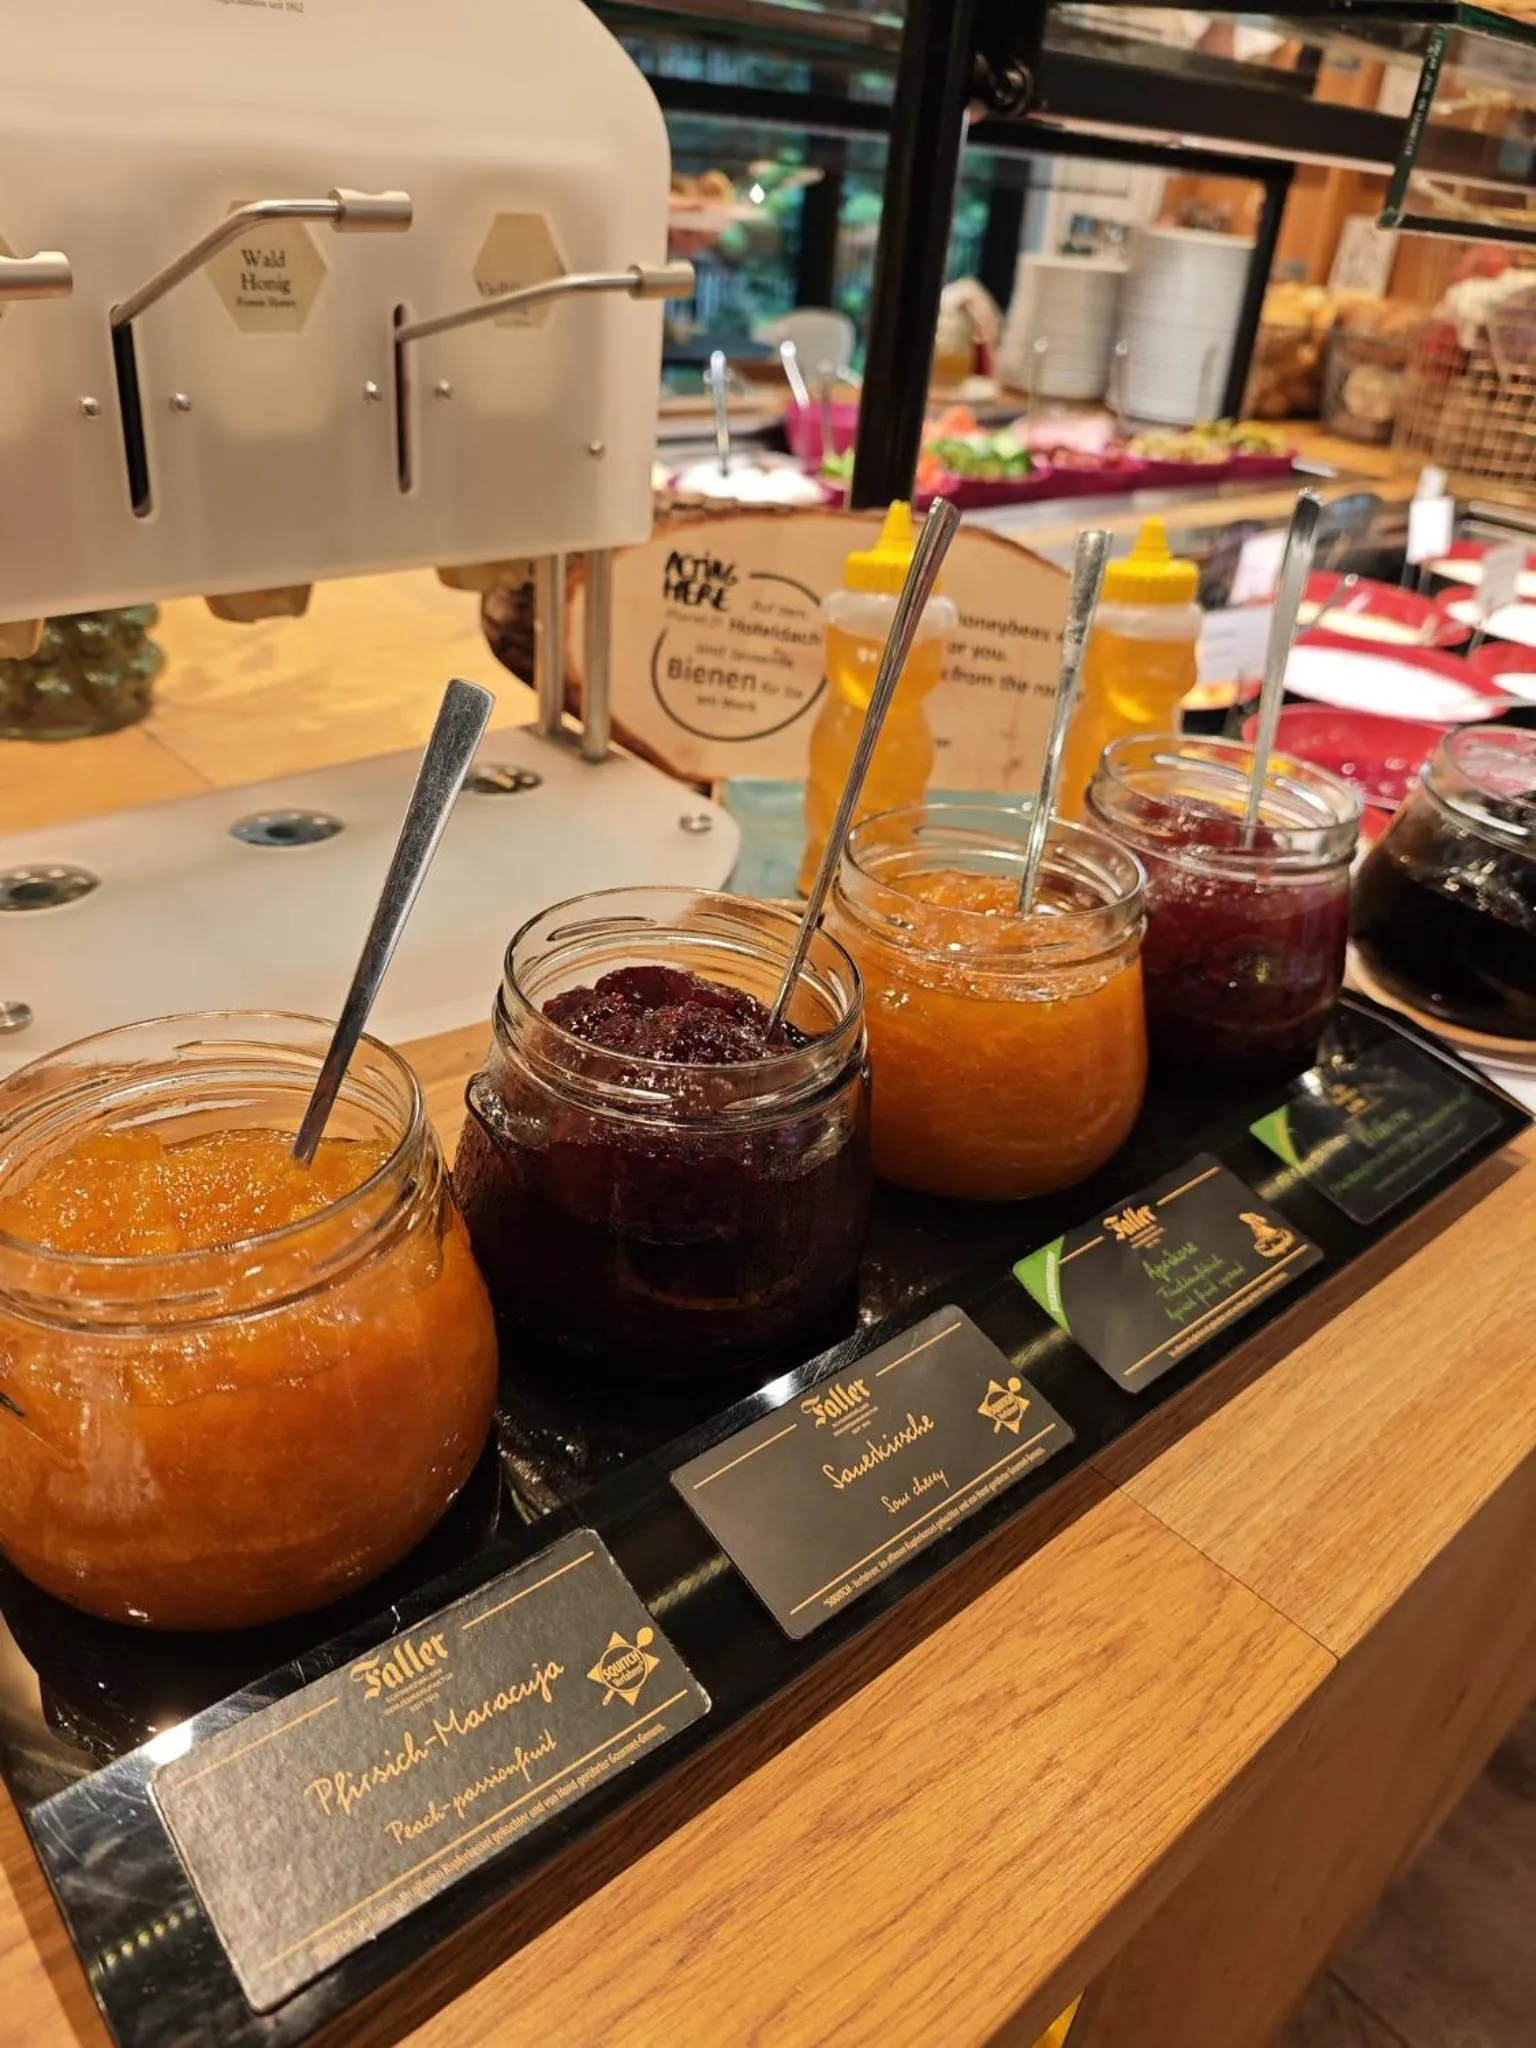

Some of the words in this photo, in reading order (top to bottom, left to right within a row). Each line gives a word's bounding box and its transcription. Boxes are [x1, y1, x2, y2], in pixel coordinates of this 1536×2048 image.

[241, 249, 286, 268] Wald
[241, 272, 291, 295] Honig
[662, 576, 729, 614] HERE
[667, 656, 758, 694] Bienen
[1102, 1205, 1157, 1242] Faller
[800, 1378, 871, 1429] Faller
[822, 1412, 935, 1490] Sauerkirsche
[881, 1495, 911, 1514] Sour
[912, 1469, 950, 1496] cherry
[350, 1631, 448, 1704] Faller
[602, 1649, 642, 1680] SQUITCH
[304, 1661, 565, 1816] Pfirsich-Maracuja
[384, 1728, 557, 1846] Peach-passionfruit
